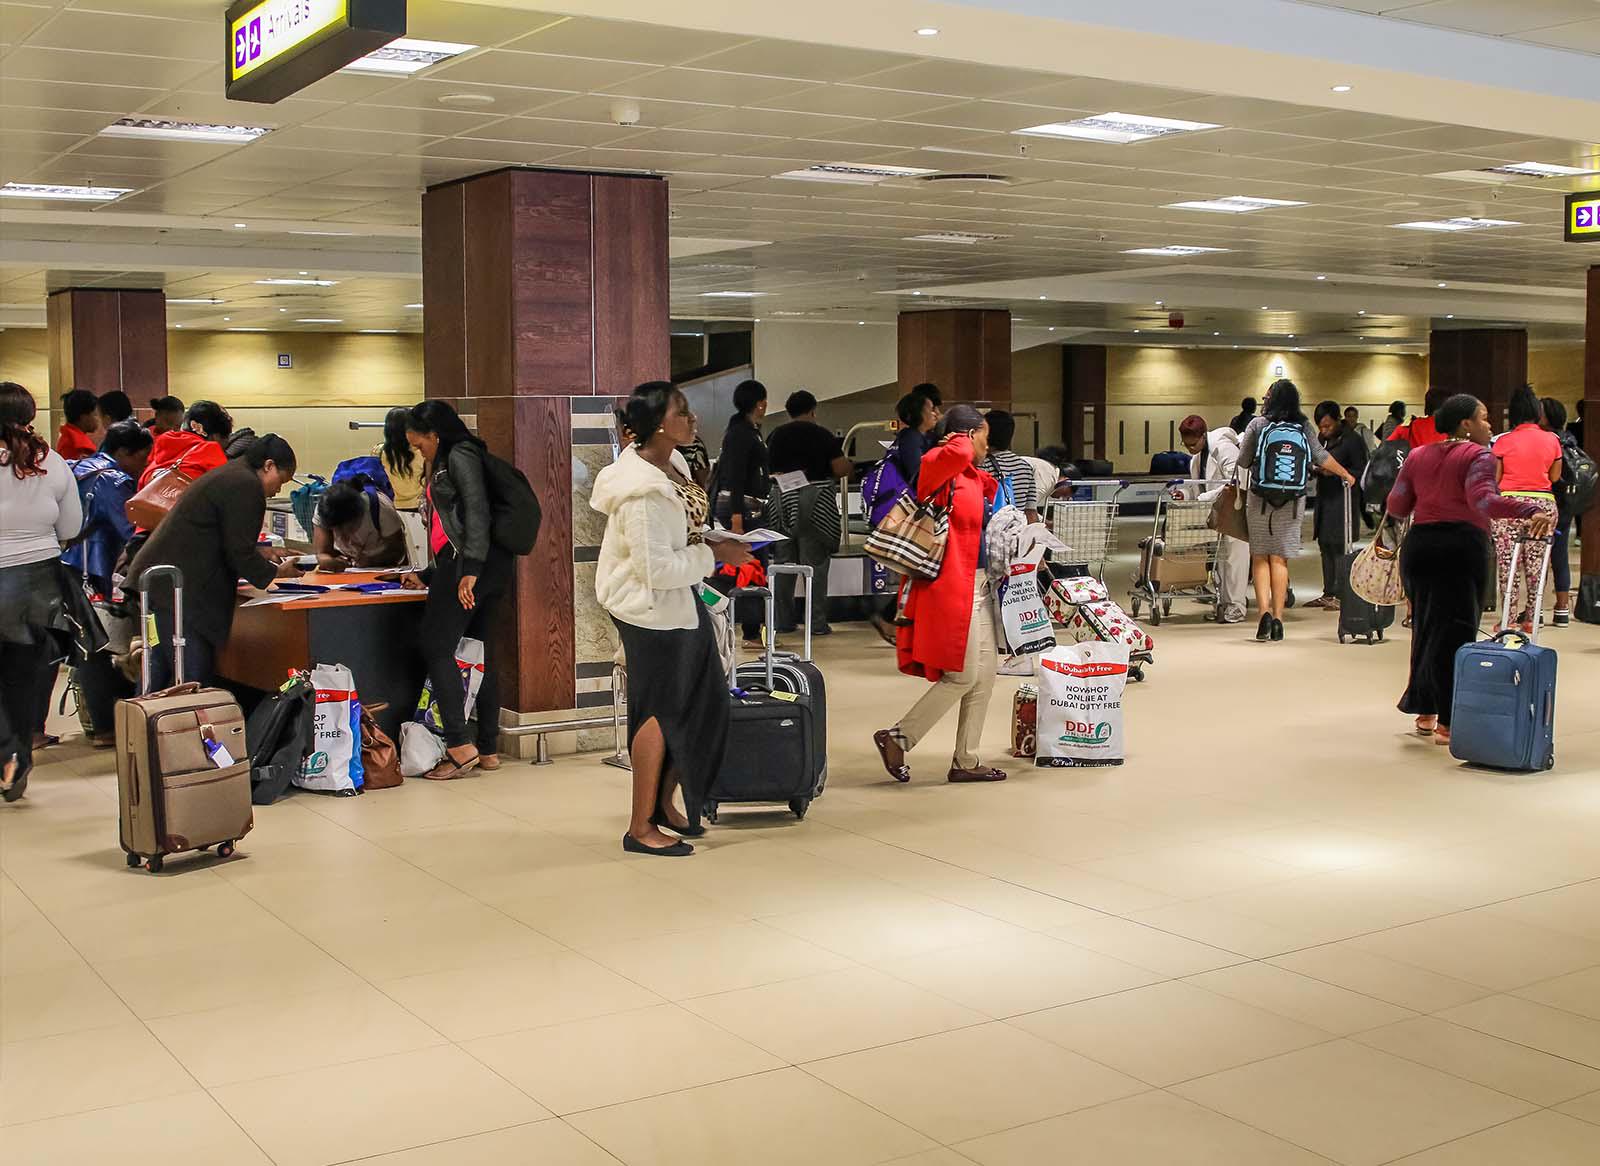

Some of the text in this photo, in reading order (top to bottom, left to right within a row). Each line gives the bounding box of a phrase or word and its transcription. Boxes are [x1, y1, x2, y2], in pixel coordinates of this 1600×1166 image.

[1050, 699, 1078, 709] DUBAI
[1103, 701, 1121, 710] FREE
[1065, 720, 1095, 733] DDF
[320, 730, 341, 739] FREE
